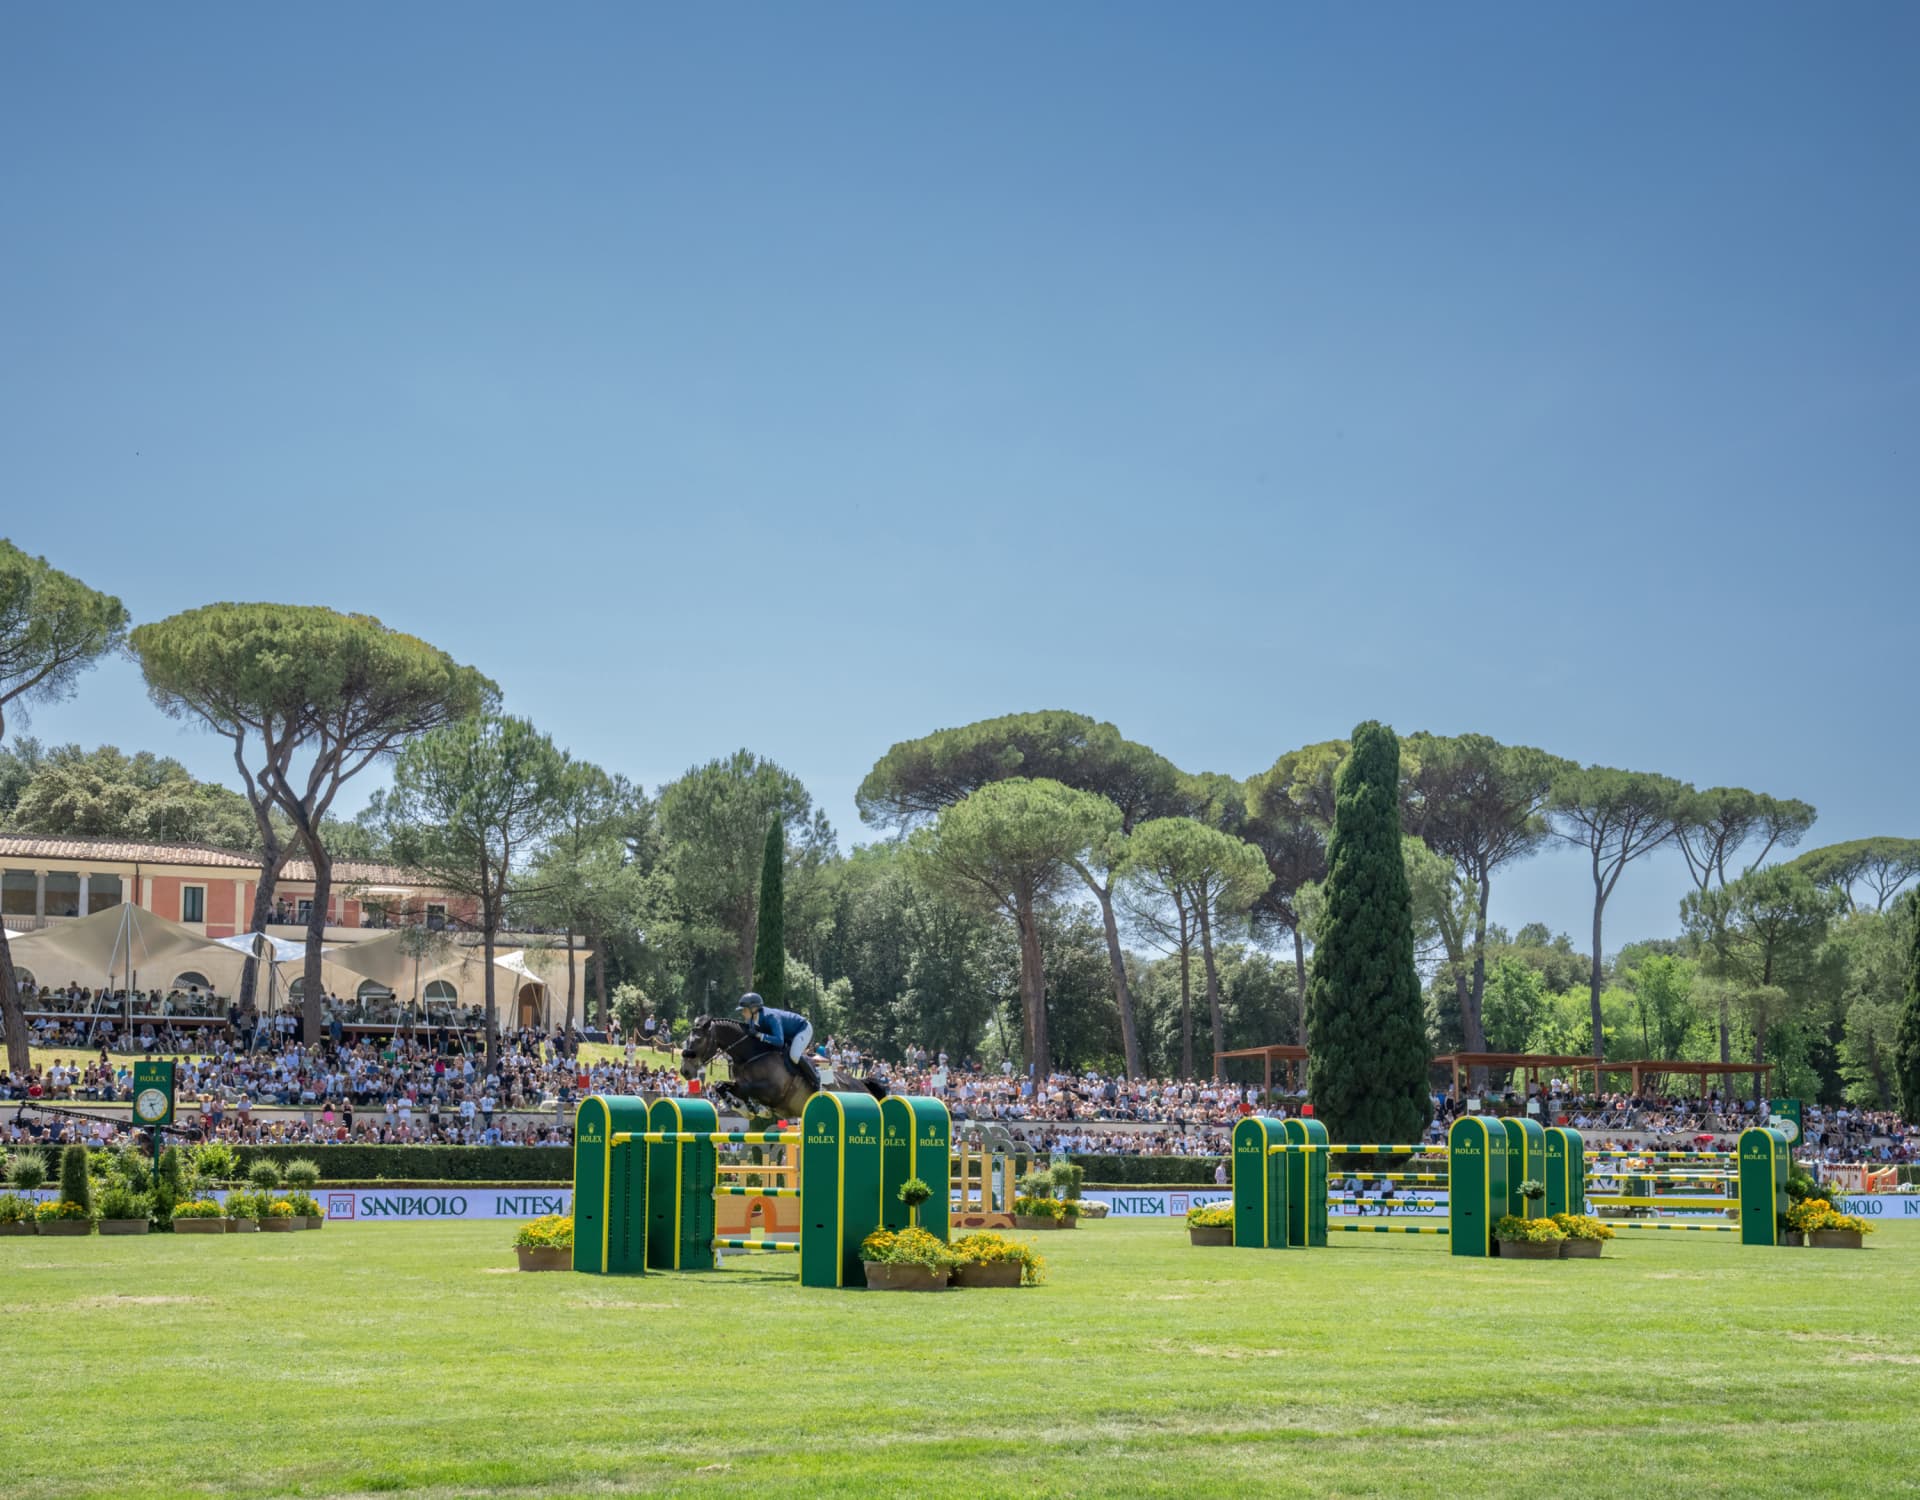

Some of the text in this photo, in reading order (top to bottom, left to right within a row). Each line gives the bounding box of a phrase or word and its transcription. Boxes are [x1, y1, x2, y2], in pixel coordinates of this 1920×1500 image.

[580, 1135, 602, 1143] ROLEX
[808, 1135, 835, 1144] ROLEX
[848, 1135, 877, 1145] ROLEX
[884, 1138, 906, 1147] OLEX
[920, 1138, 945, 1147] ROLEX
[360, 1196, 468, 1216] SANPAOLO
[495, 1196, 564, 1215] INTESA
[1112, 1197, 1165, 1214] INTESA
